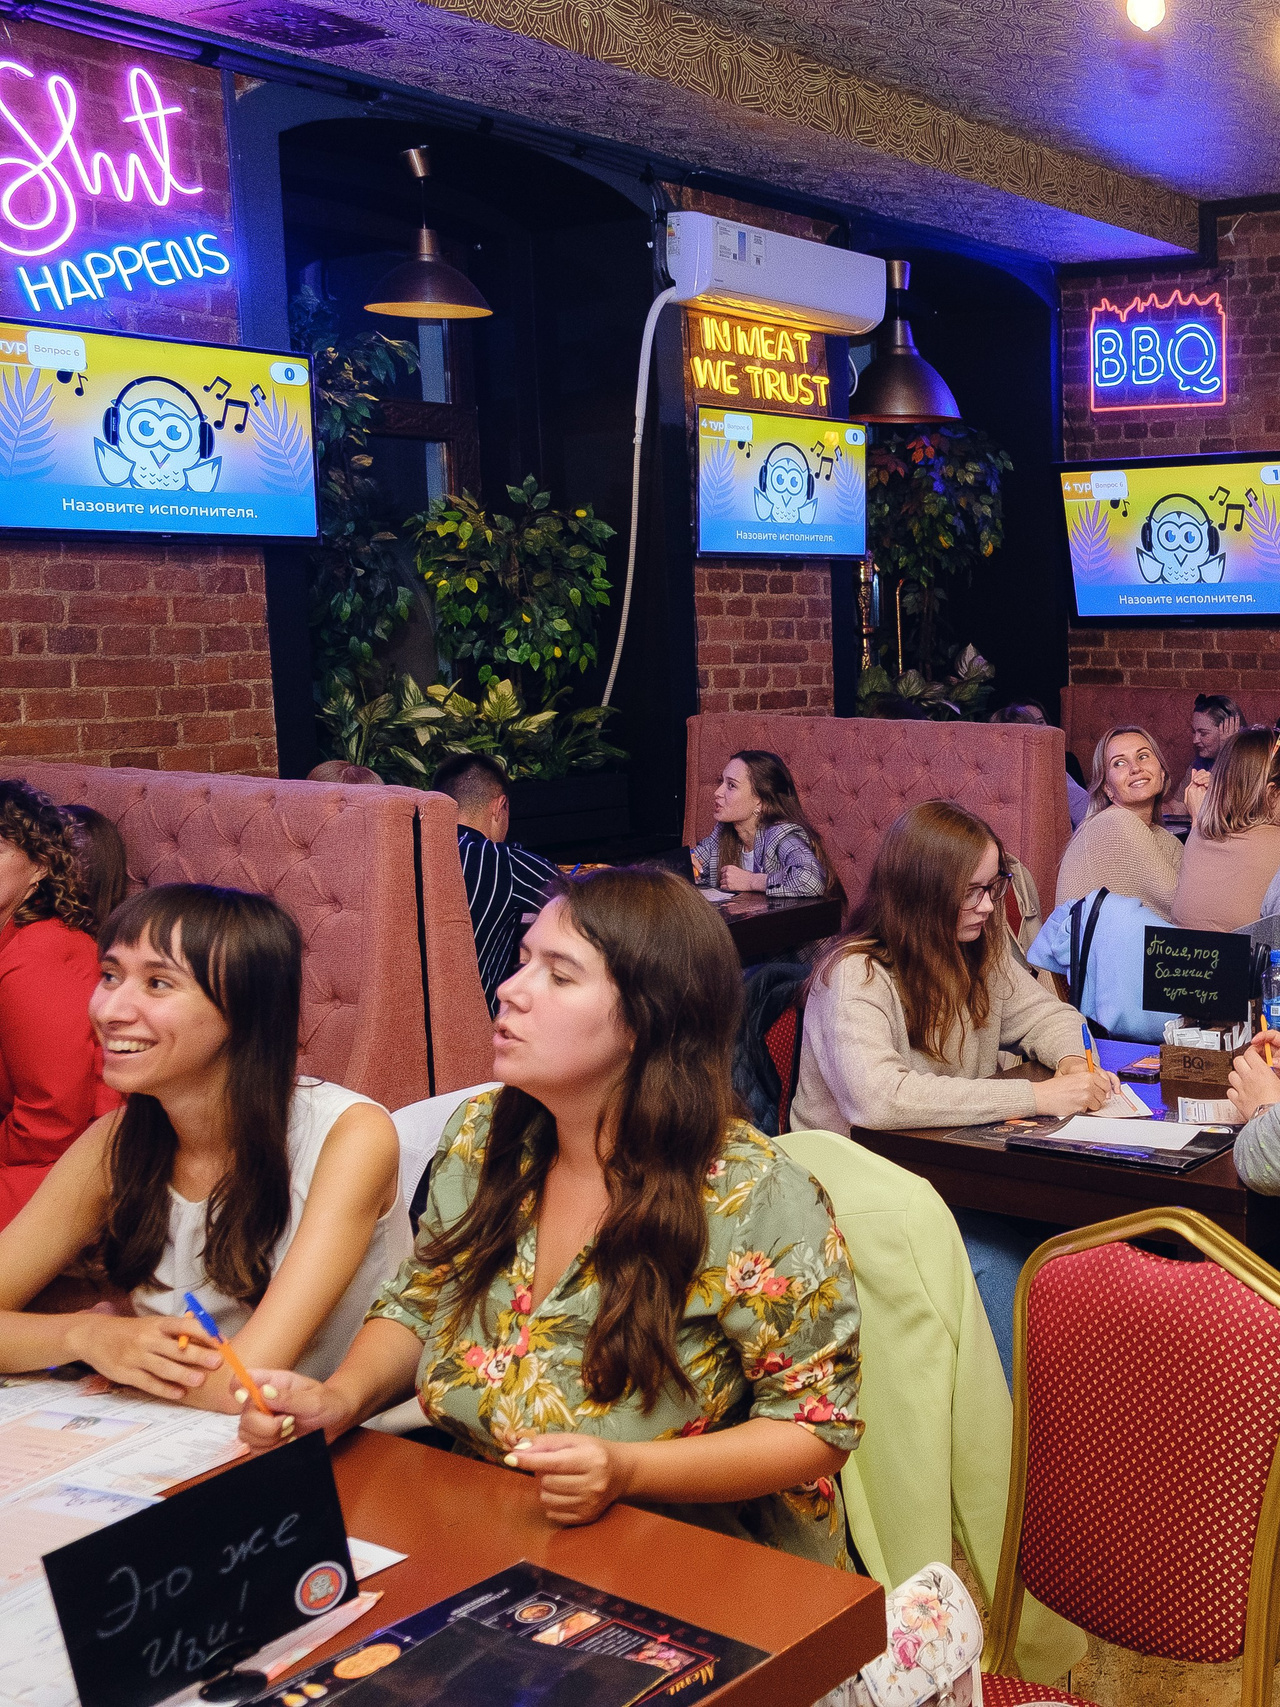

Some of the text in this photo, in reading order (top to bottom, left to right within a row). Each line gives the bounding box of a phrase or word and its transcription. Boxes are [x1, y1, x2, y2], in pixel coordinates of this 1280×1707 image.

[18, 234, 229, 312] HAPPENS
[702, 316, 811, 363] IN MEAT
[34, 344, 80, 357] Вопрос 6
[1095, 323, 1220, 393] BBQ
[284, 368, 295, 381] 0
[692, 356, 830, 406] WE TRUST
[701, 418, 725, 432] 4 тур
[852, 433, 858, 442] 0
[1273, 469, 1279, 480] 1
[1064, 482, 1091, 493] 4 тур
[62, 497, 258, 519] Назовите исполнителя.
[736, 530, 835, 542] Назовите исполнителя.
[1119, 594, 1256, 605] Назовите исполнителя.
[1163, 987, 1218, 1004] чуть-чуть
[97, 1512, 300, 1639] Это же
